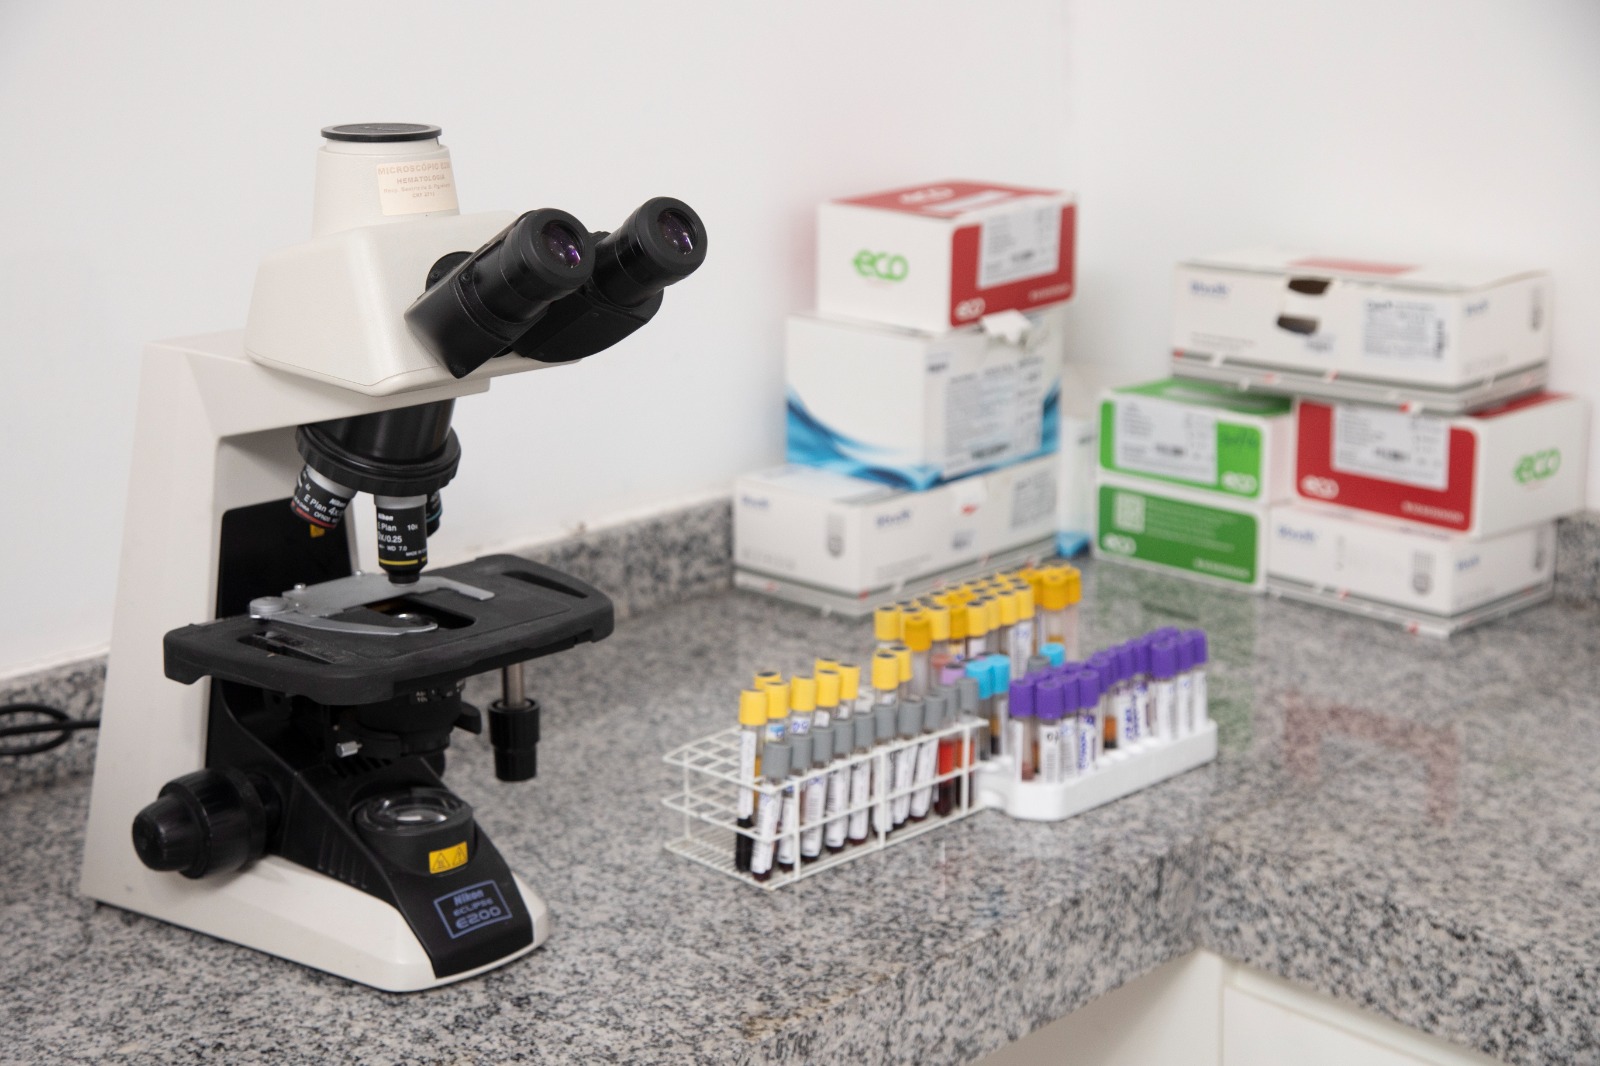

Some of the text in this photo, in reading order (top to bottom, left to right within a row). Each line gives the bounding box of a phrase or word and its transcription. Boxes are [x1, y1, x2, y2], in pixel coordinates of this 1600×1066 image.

[852, 250, 909, 282] eco
[1513, 448, 1562, 484] eco
[304, 493, 311, 503] E
[310, 498, 327, 513] Plan
[381, 522, 397, 532] Plan
[454, 889, 484, 906] Nikon
[456, 906, 500, 928] E200
